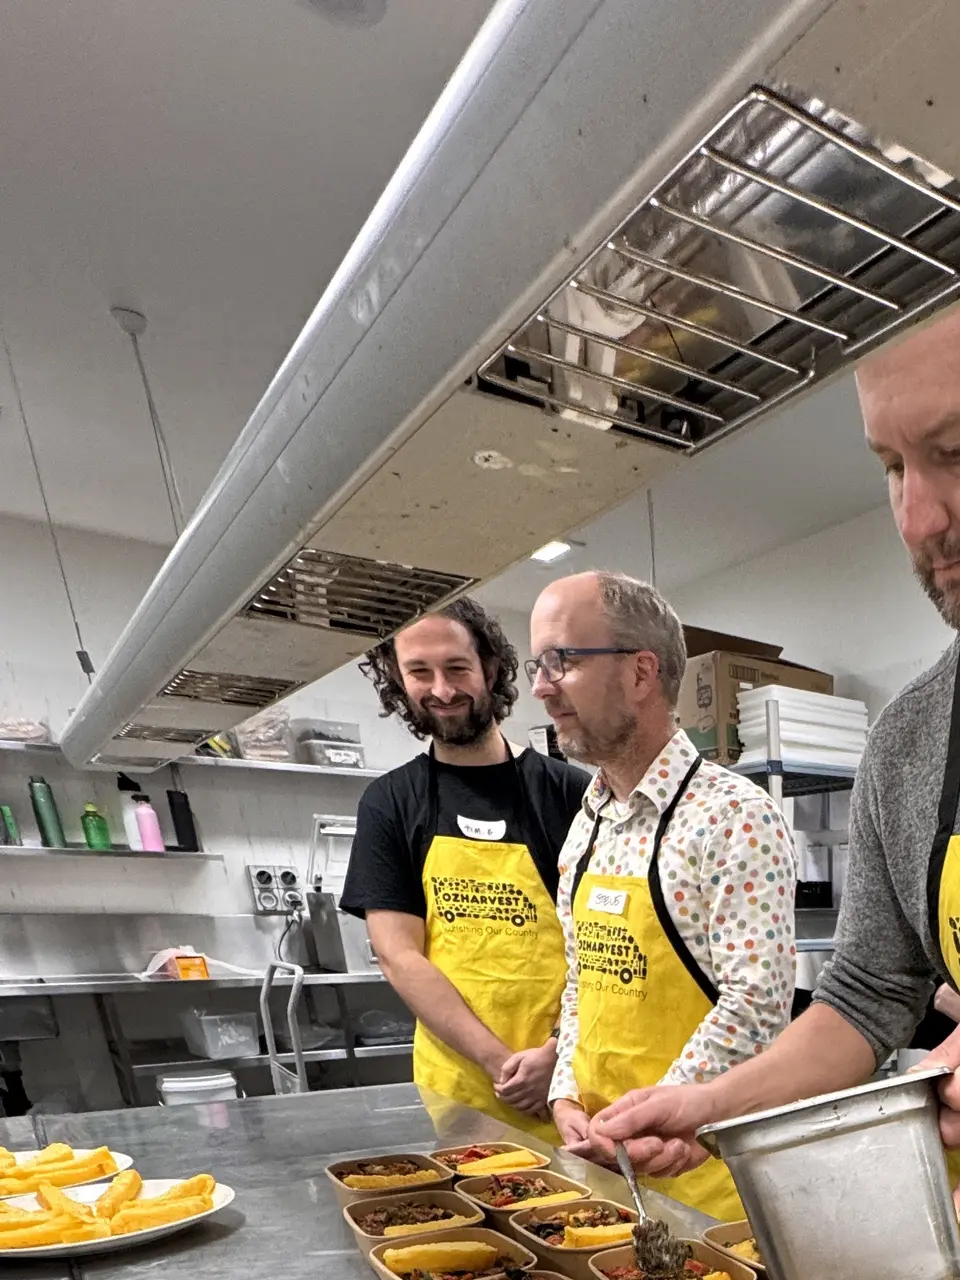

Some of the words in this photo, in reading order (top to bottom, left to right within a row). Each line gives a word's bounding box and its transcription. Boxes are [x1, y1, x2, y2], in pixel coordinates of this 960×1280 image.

[443, 892, 520, 907] OZHARVEST
[485, 926, 502, 936] Our
[505, 927, 539, 938] Country
[611, 983, 648, 1001] Country
